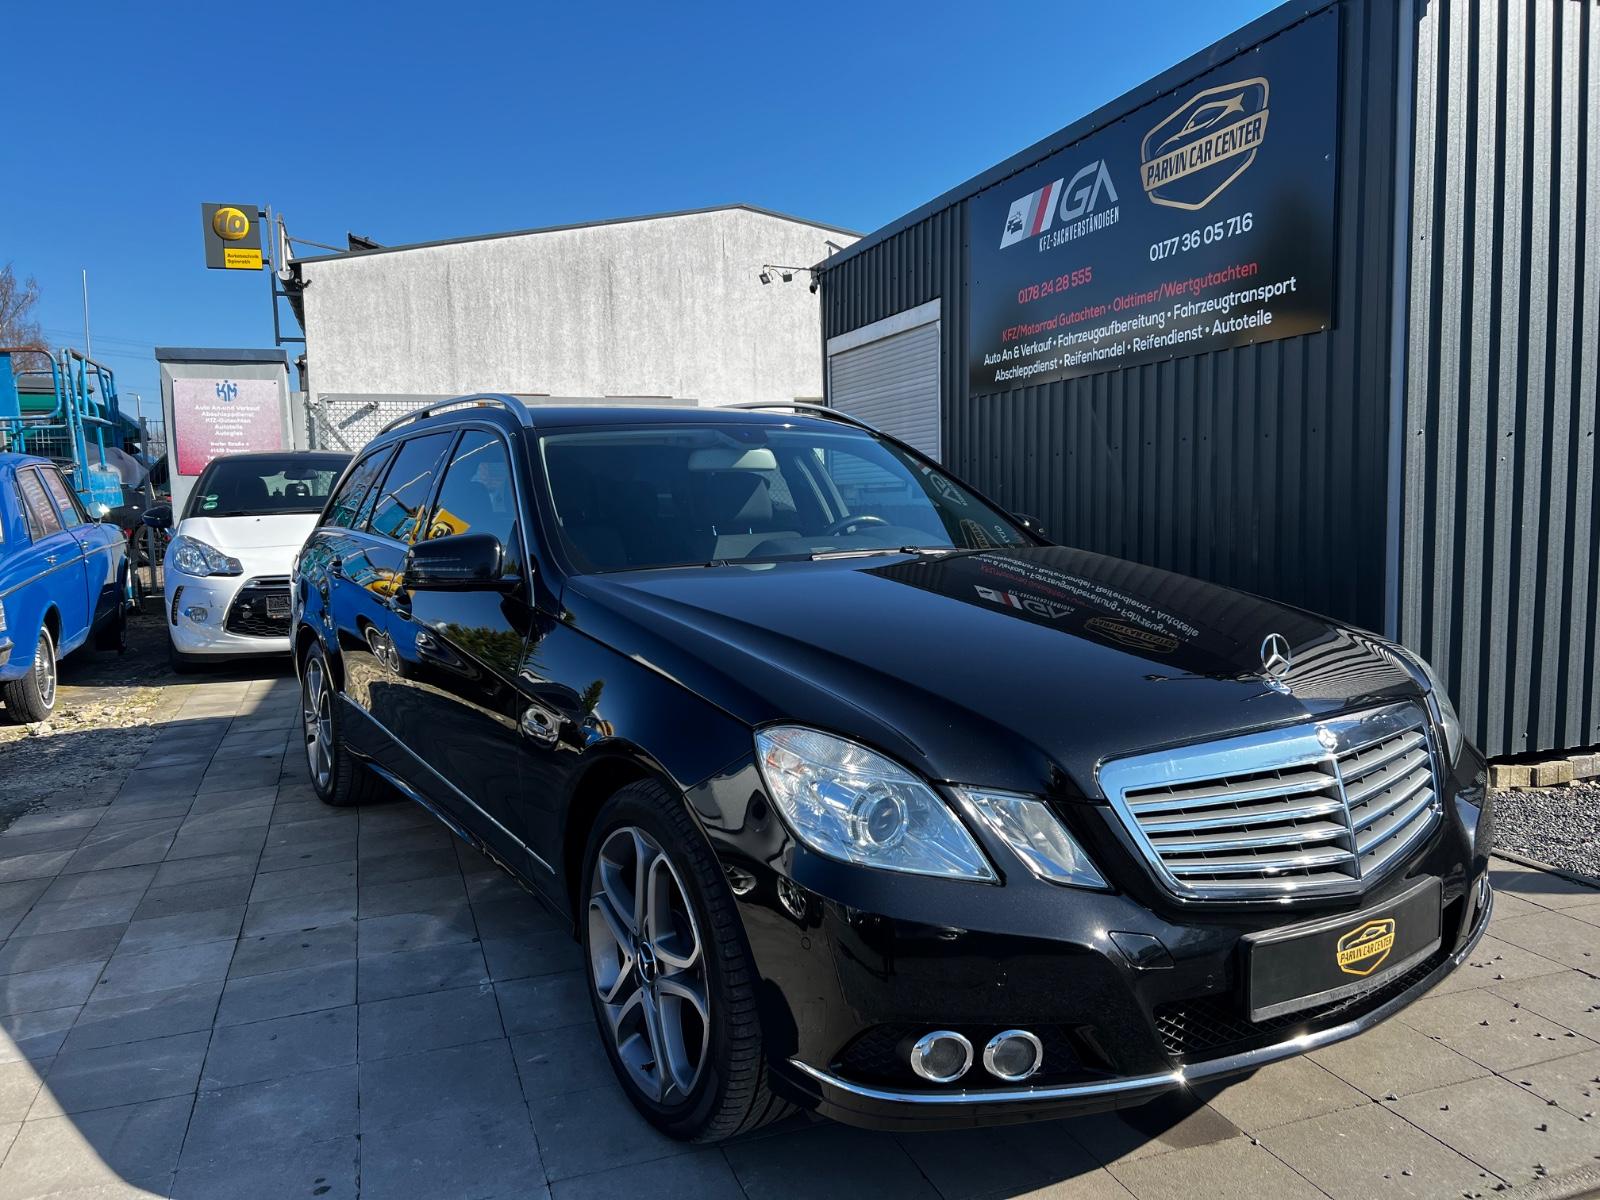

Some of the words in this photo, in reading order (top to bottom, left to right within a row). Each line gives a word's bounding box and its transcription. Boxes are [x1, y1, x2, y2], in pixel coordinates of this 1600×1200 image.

[1146, 150, 1188, 187] PARVIN
[1189, 139, 1213, 169] CAR
[1214, 117, 1262, 157] CENTER
[1039, 205, 1120, 252] KFZ-SACHVERSTÄNDIGEN
[1150, 237, 1180, 262] 0177
[1182, 229, 1201, 252] 36
[1203, 222, 1224, 244] 05
[1227, 212, 1253, 238] 716
[1002, 315, 1058, 343] KFZ/Motorrad
[1059, 305, 1106, 327] Gutachten
[1113, 262, 1258, 312] Oldtimer/Wertgutachten
[1018, 287, 1040, 304] 0178
[1041, 280, 1054, 298] 24
[1055, 274, 1070, 292] 28
[1071, 266, 1093, 288] 555
[984, 352, 1001, 366] Auto
[1002, 349, 1013, 361] An
[1013, 346, 1020, 358] &
[1020, 336, 1052, 358] Verkauf
[1057, 311, 1166, 348] Fahrzeugaufbereitung
[1173, 275, 1297, 320] Fahrzeugtransport
[995, 359, 1058, 382] Abschleppdienst
[1064, 340, 1125, 368] Reifenhandel
[1132, 325, 1203, 353] Reifendienst
[1211, 309, 1273, 336] Autoteile
[1340, 946, 1362, 963] PARVIN
[1363, 943, 1374, 956] CAR
[1374, 935, 1392, 952] CENTER
